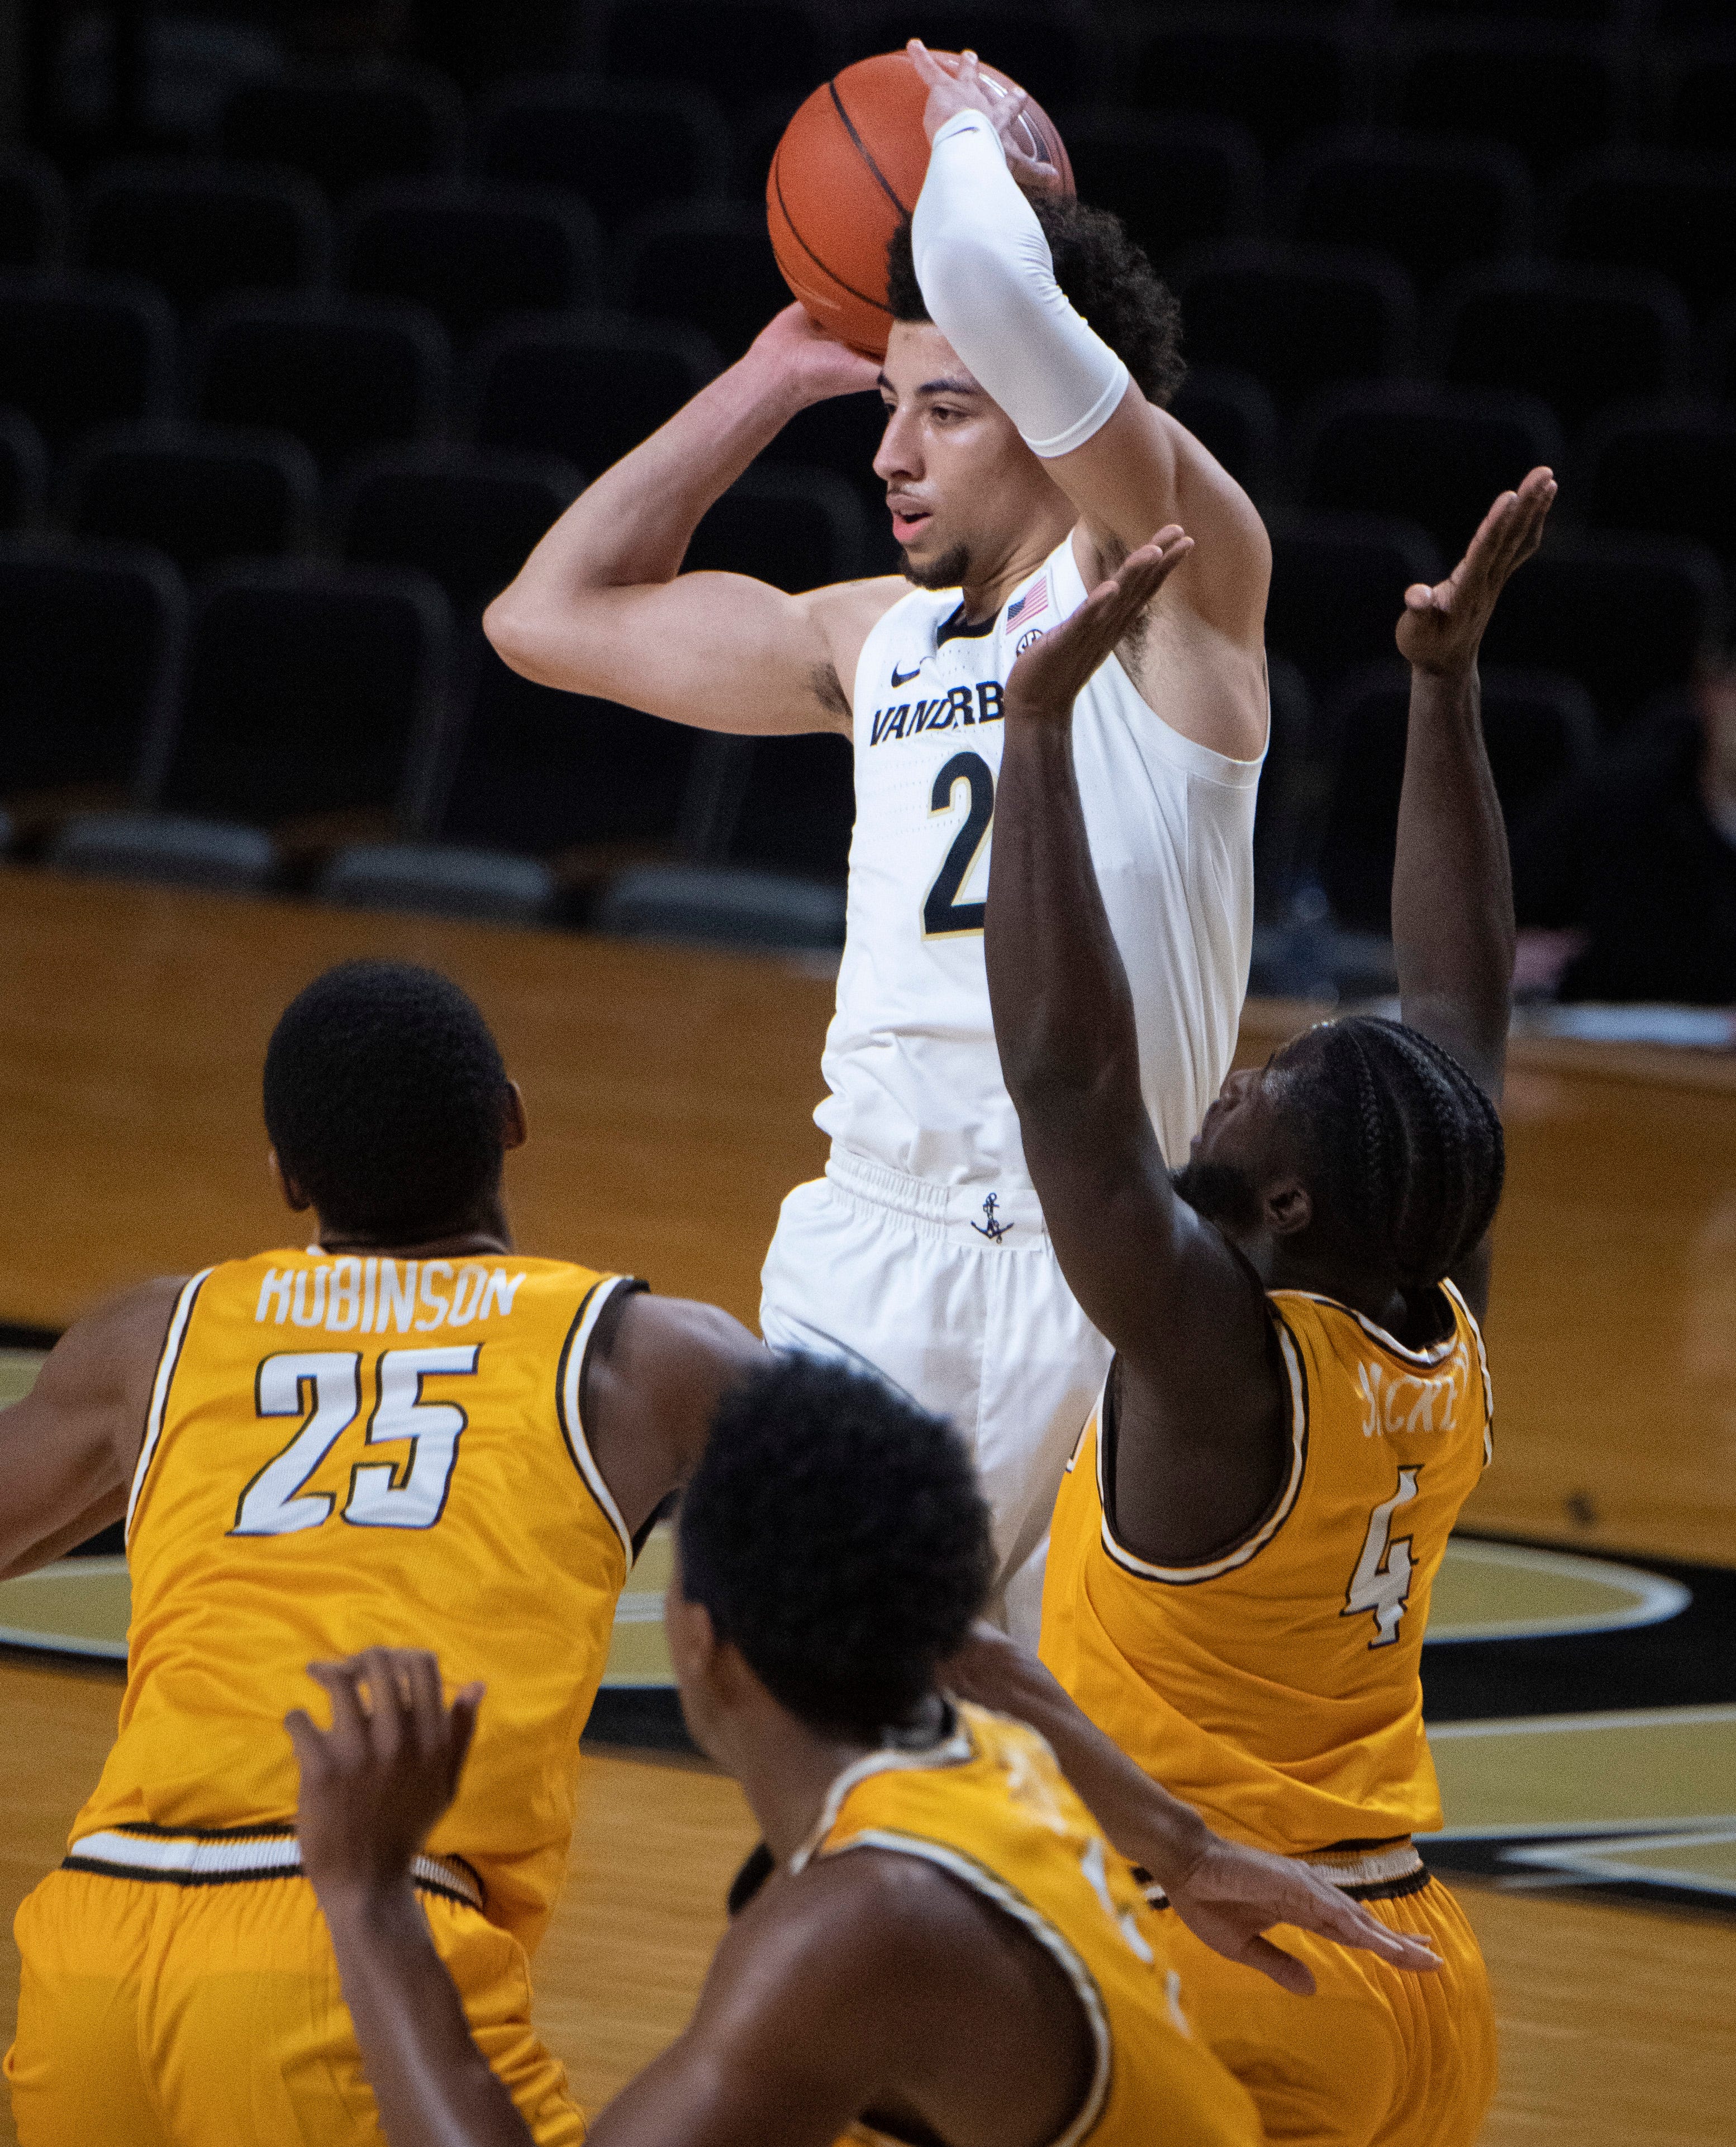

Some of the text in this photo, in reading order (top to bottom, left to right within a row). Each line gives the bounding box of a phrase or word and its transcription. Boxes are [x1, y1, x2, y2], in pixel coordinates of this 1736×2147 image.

[870, 680, 1005, 747] VANDRB
[920, 748, 996, 942] 2
[255, 1257, 527, 1333] ROBINSON
[224, 1341, 485, 1537] 25
[1339, 1464, 1425, 1650] 4
